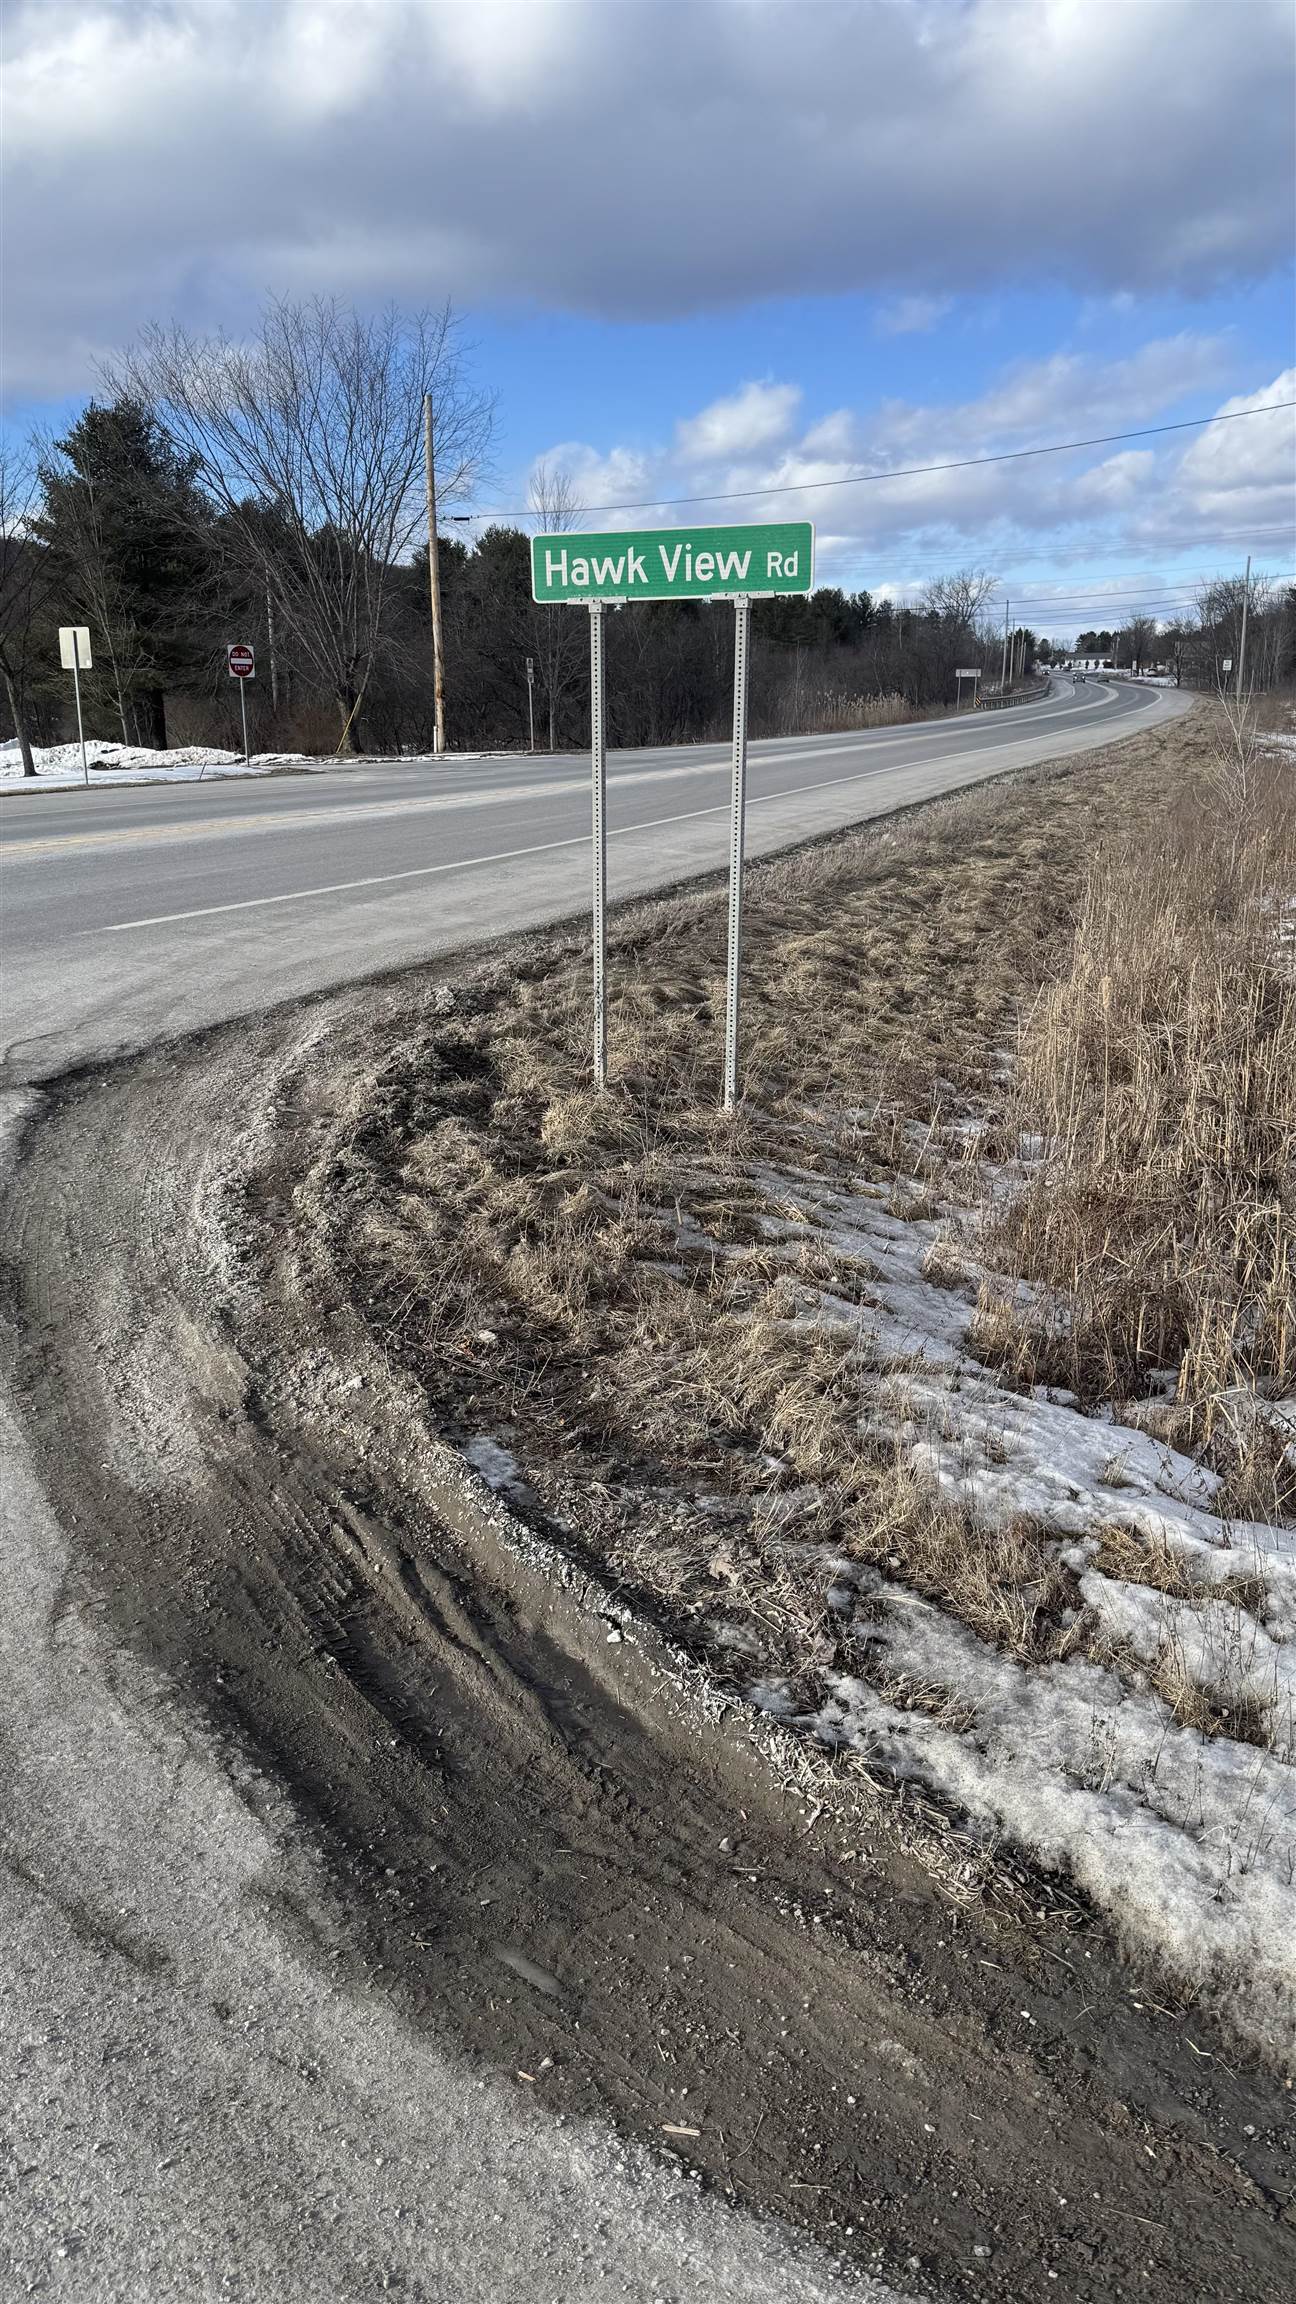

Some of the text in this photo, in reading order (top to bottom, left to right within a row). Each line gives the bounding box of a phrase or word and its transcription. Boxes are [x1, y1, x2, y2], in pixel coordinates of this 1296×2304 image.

[545, 544, 798, 587] Hawk View Rd
